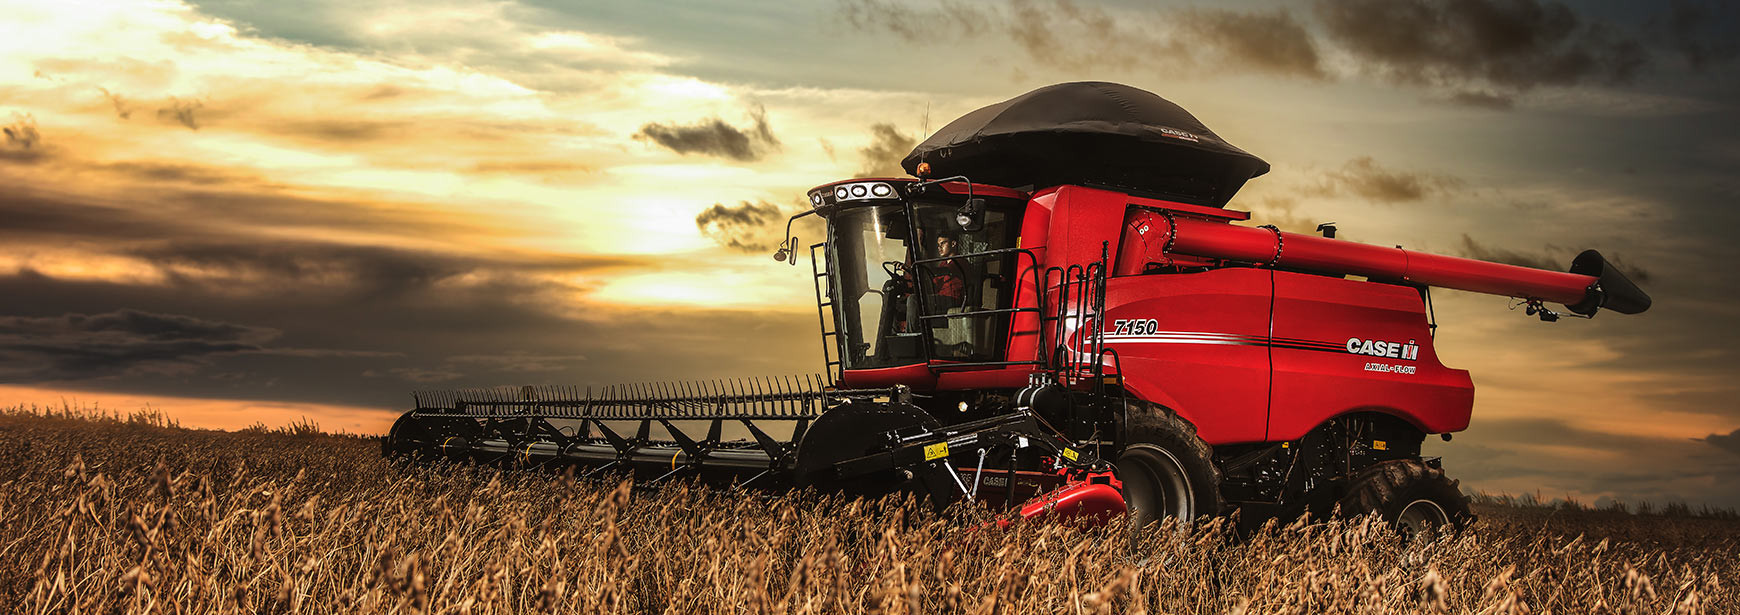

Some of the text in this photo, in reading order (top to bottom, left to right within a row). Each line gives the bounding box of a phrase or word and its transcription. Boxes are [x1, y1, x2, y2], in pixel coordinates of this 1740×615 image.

[1114, 319, 1159, 336] 7150
[1346, 337, 1400, 358] CASE
[1364, 362, 1416, 375] AXIAL-FLOW
[983, 476, 1004, 487] CASE
